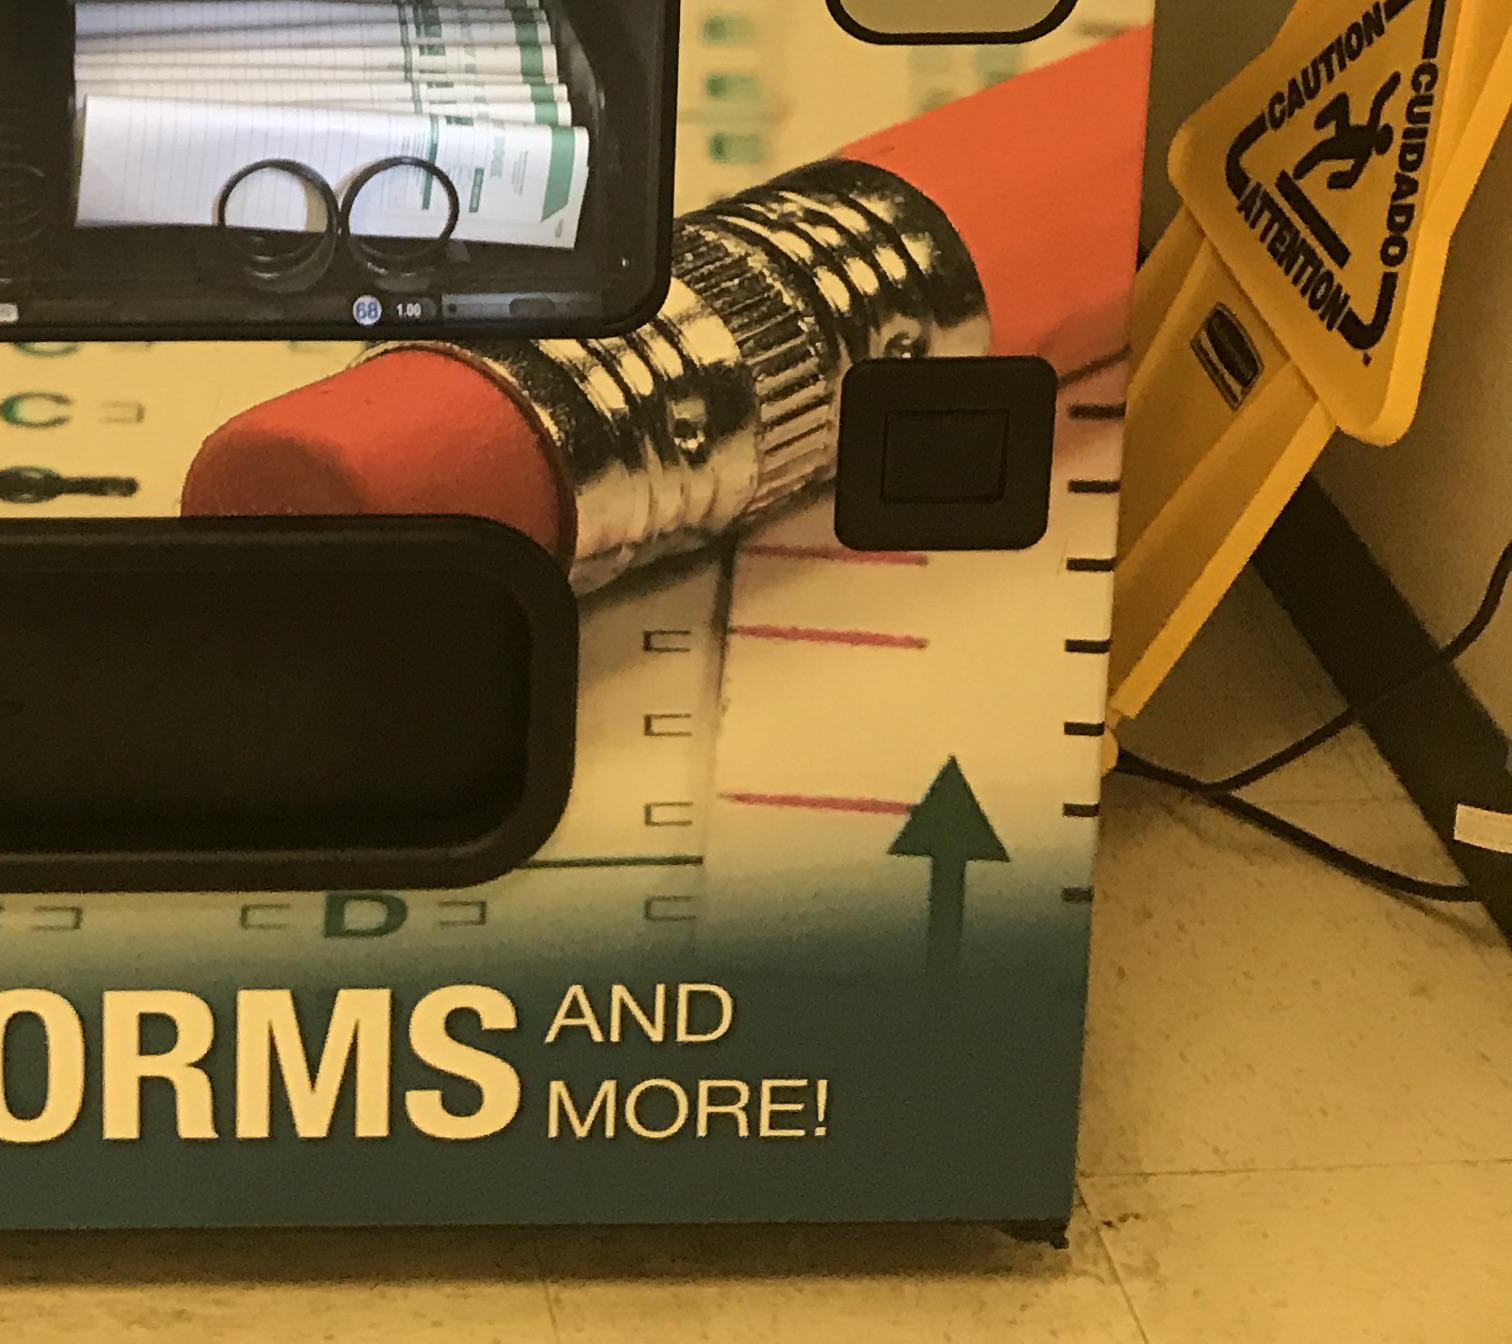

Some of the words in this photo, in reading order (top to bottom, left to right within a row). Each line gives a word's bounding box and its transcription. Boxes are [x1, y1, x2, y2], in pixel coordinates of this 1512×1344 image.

[1266, 0, 1387, 131] CAUTION
[1380, 61, 1439, 268] CUIDADO
[1237, 182, 1352, 331] ATTENTION
[356, 302, 378, 319] 68
[397, 303, 421, 317] 1.00
[544, 982, 734, 1044] AND
[548, 1077, 831, 1140] MORE!
